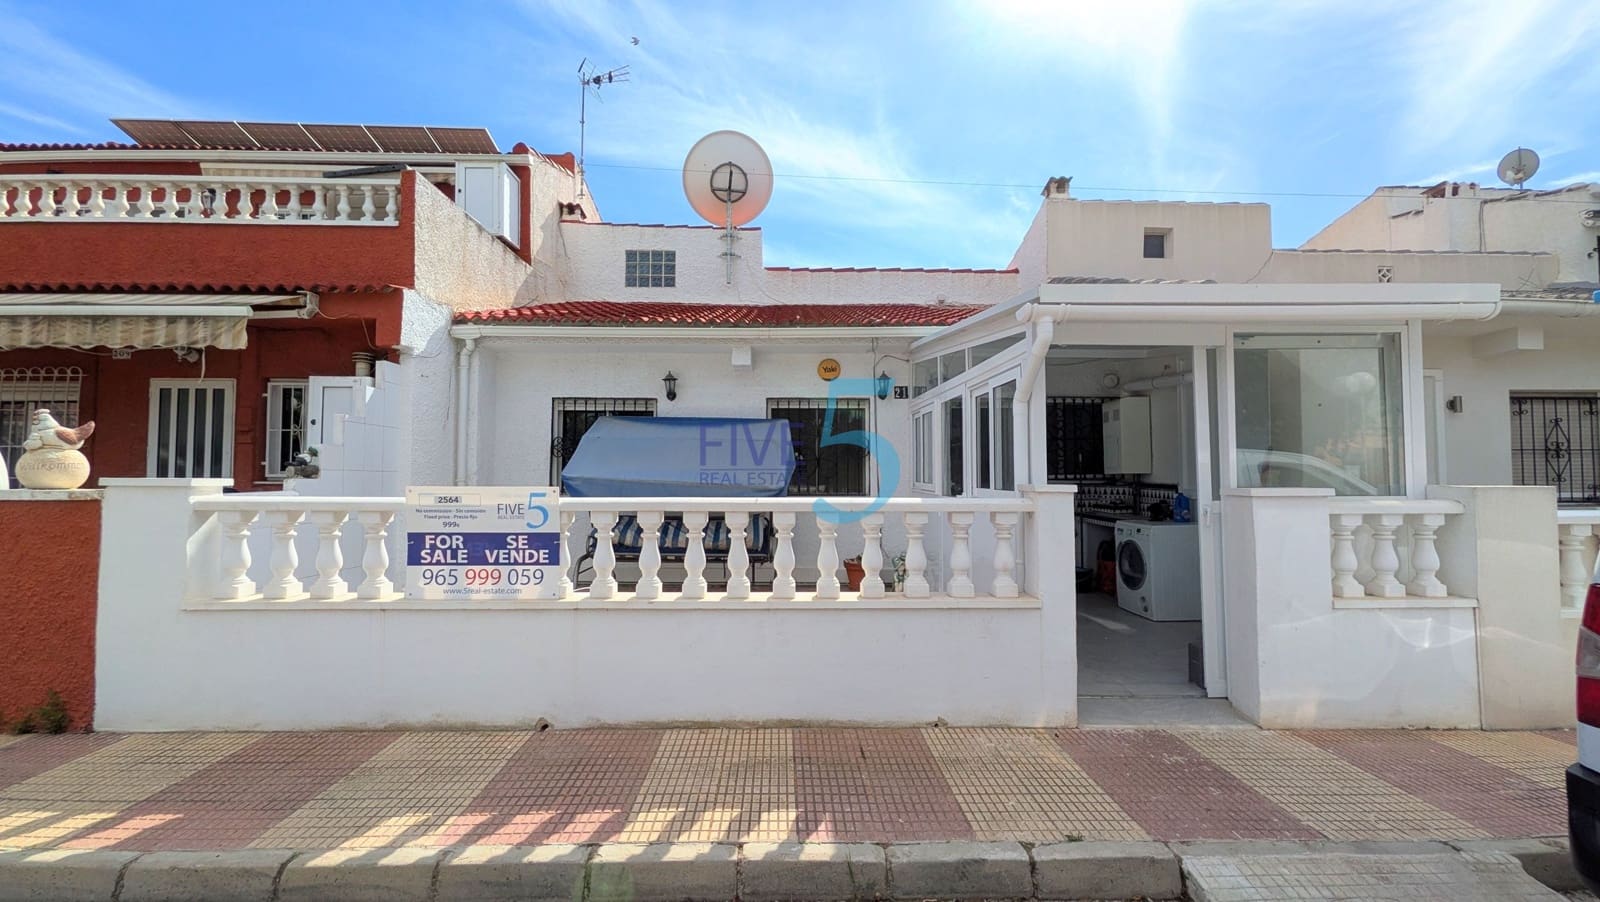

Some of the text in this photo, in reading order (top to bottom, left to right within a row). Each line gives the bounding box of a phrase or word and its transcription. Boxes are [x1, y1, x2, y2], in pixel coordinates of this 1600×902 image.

[895, 387, 907, 398] 21
[438, 496, 459, 504] 2564
[497, 492, 549, 529] FIVE 5
[425, 535, 464, 549] FOR
[506, 535, 529, 549] SE
[420, 549, 469, 564] SALE
[484, 549, 550, 564] VENDE
[422, 568, 544, 586] 965 999 059
[442, 587, 522, 595] www.5real-estate.com
